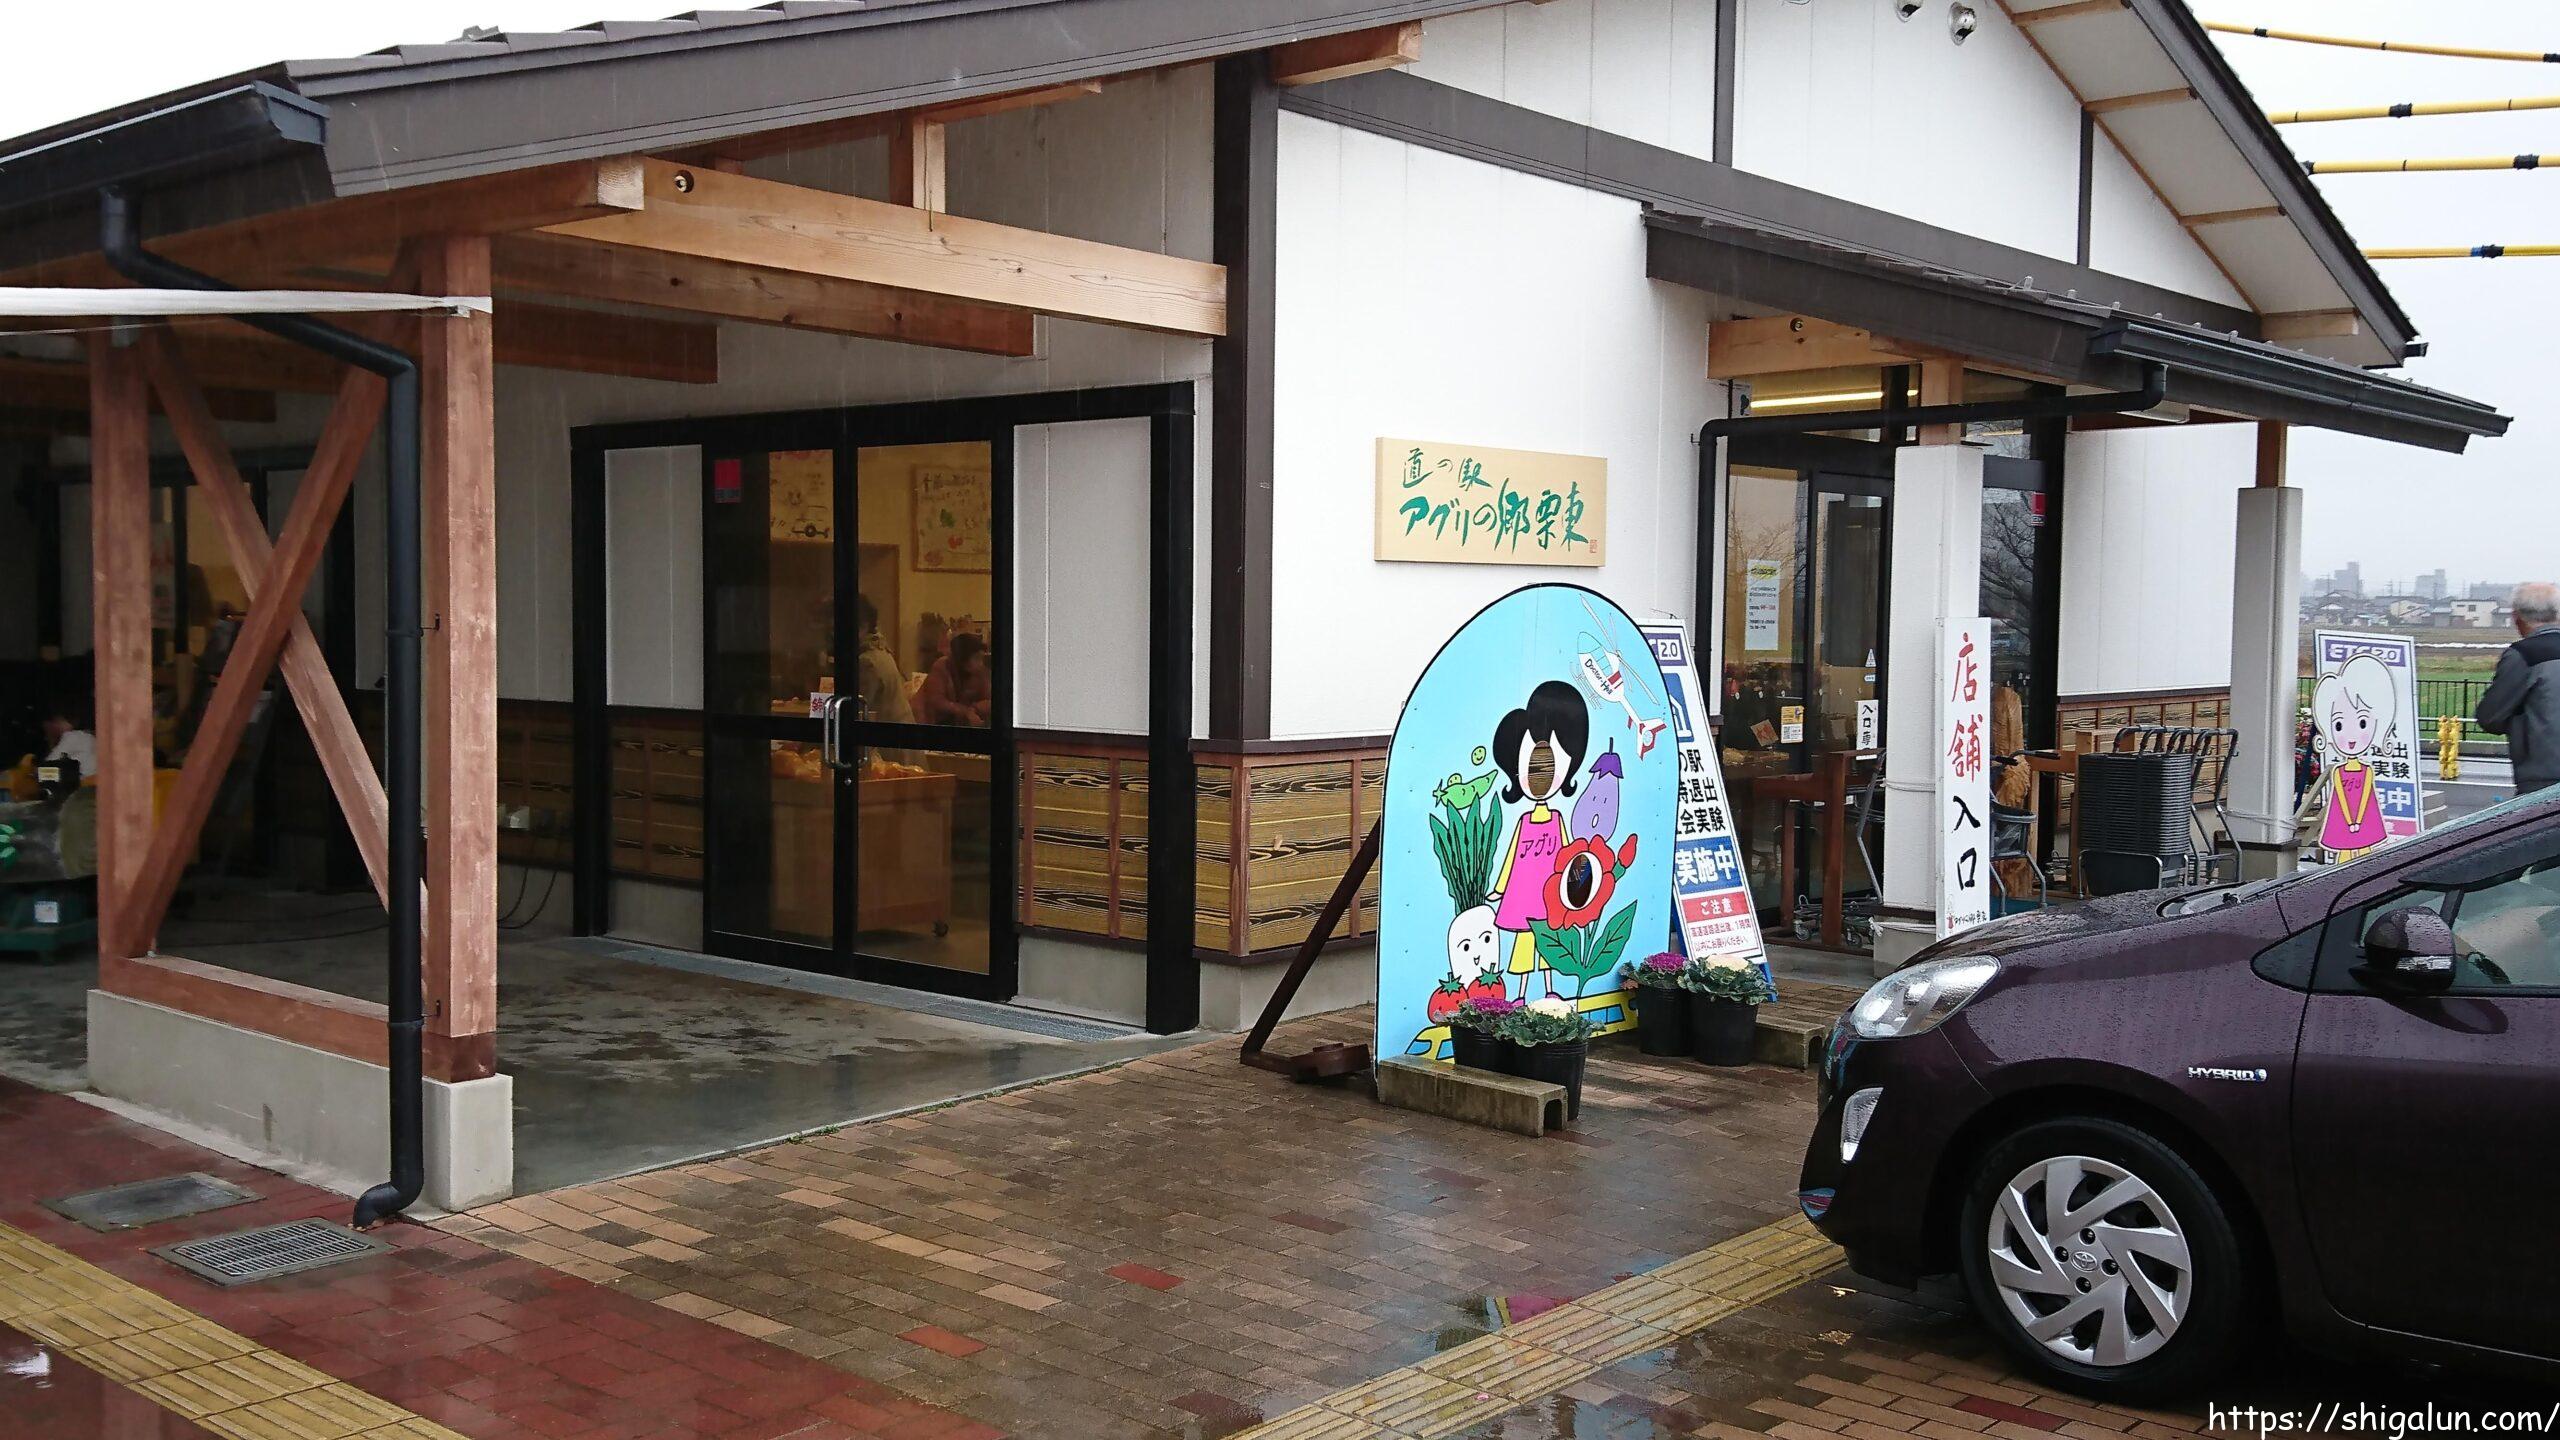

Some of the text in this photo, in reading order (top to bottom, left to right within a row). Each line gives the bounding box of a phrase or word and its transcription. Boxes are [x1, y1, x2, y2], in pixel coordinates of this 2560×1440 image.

[1403, 447, 1494, 492] 道の駅
[1398, 478, 1589, 555] アグリの郷栗東
[1946, 632, 1984, 892] 店舗入口
[1676, 806, 1726, 835] 会実験
[1518, 834, 1558, 860] アグリ
[1674, 845, 1736, 886] 実施中
[1700, 897, 1733, 916] ご注意
[2187, 1066, 2255, 1081] HYBRID
